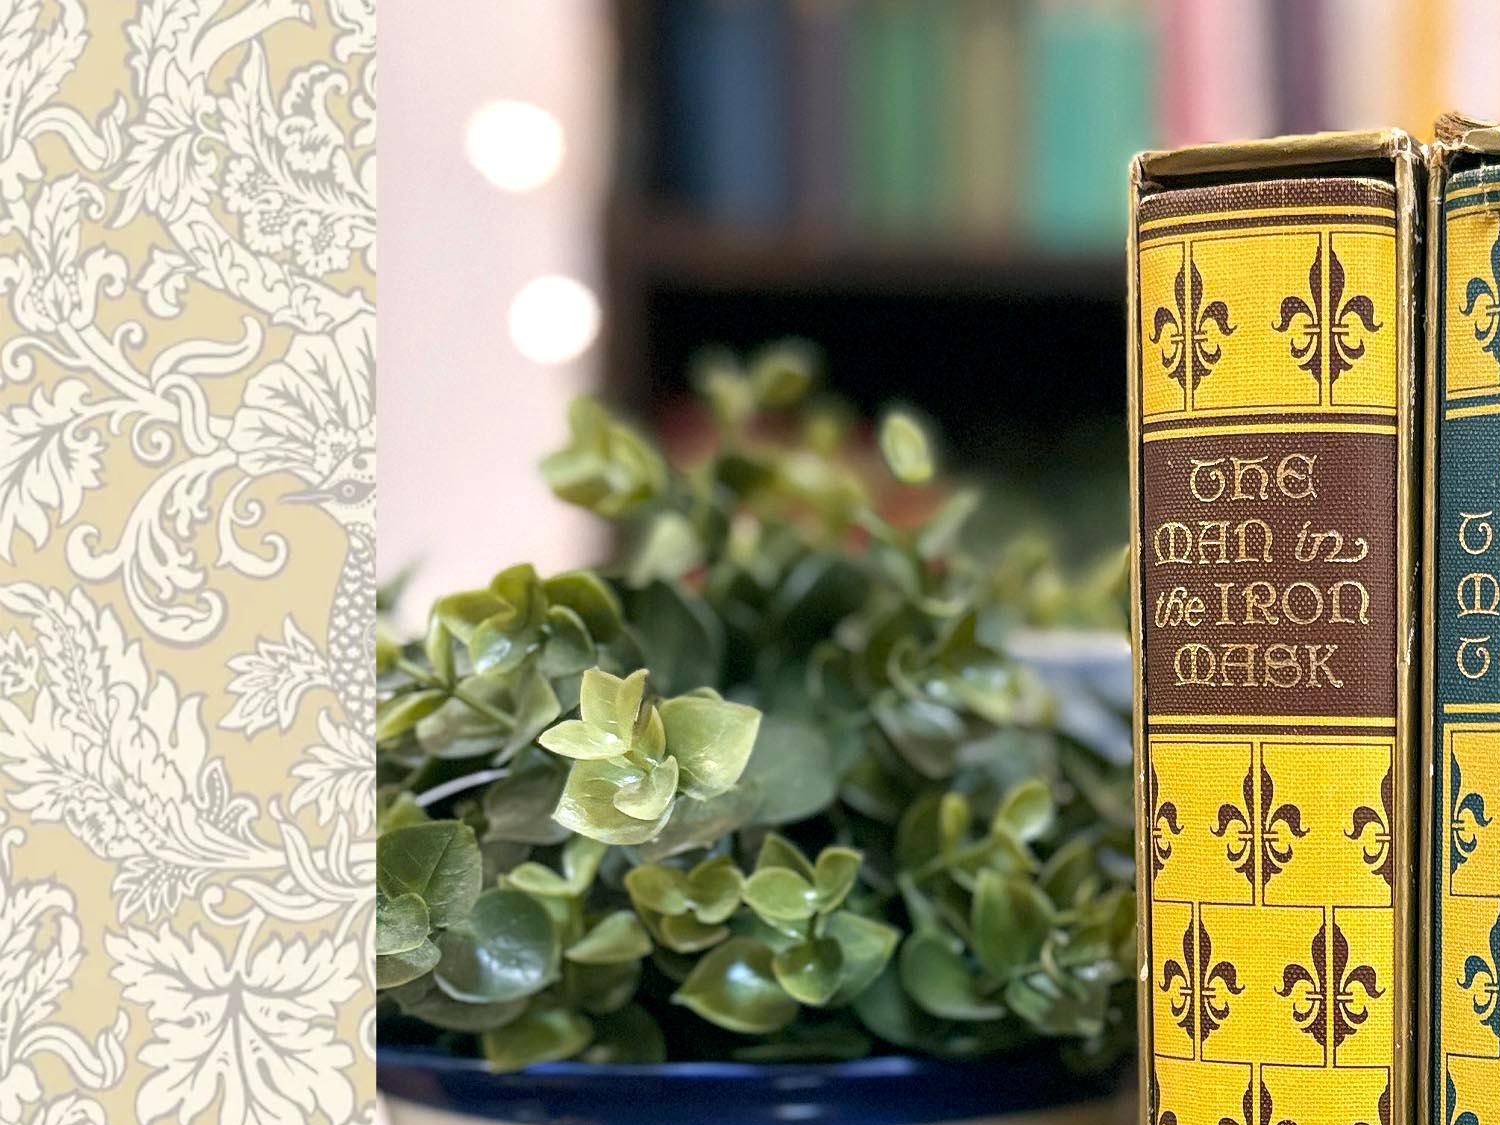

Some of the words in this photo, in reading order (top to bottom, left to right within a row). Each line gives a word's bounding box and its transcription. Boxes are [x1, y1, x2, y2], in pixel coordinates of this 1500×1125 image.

[1190, 453, 1318, 502] THE
[1154, 519, 1273, 566] MAN
[1295, 521, 1369, 563] in
[1154, 587, 1206, 628] the
[1214, 581, 1370, 626] IRON
[1174, 643, 1344, 688] MASK
